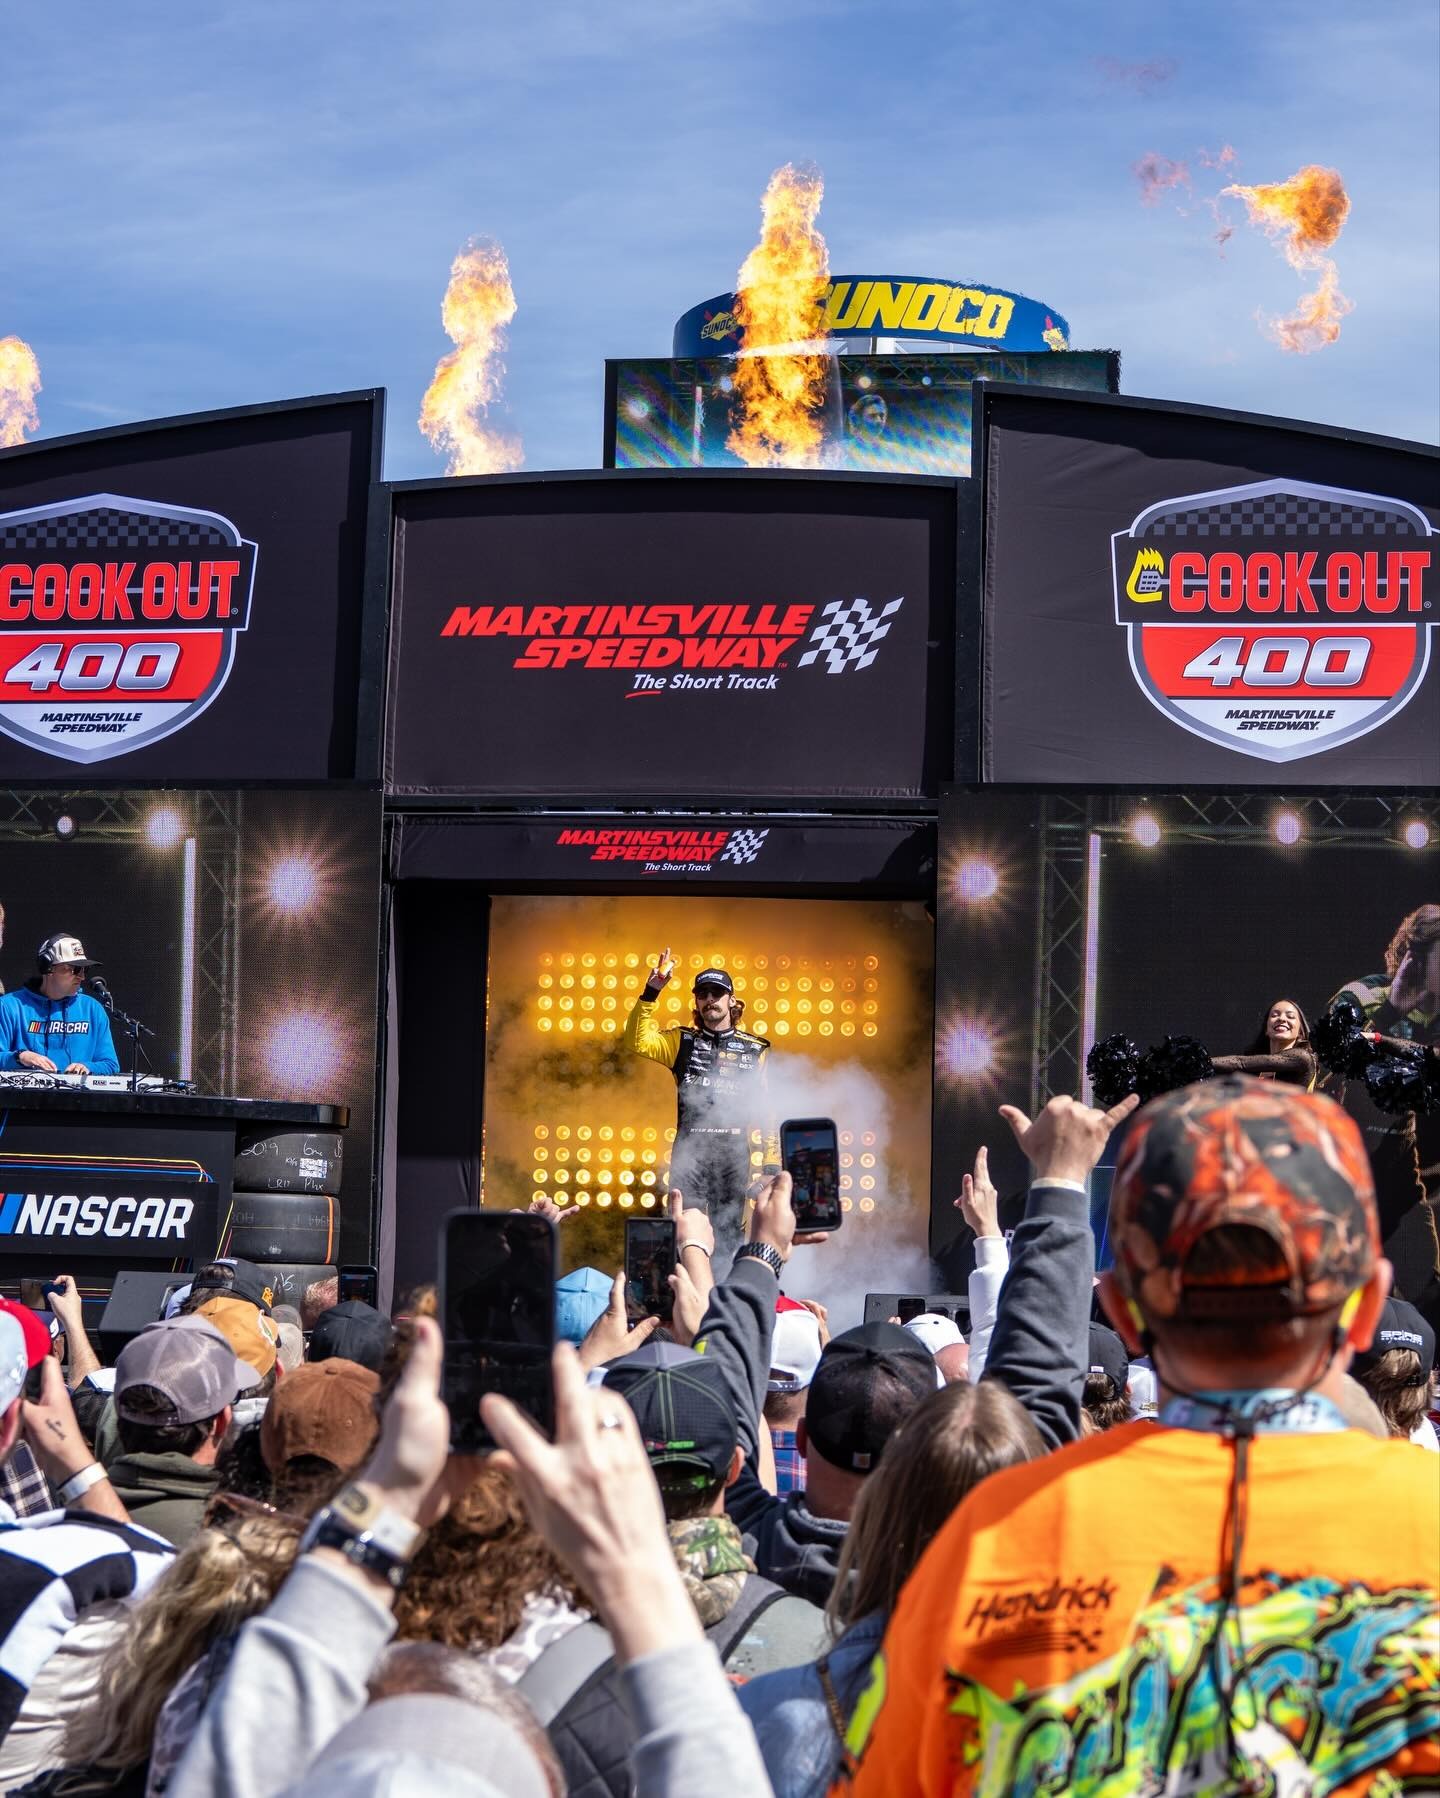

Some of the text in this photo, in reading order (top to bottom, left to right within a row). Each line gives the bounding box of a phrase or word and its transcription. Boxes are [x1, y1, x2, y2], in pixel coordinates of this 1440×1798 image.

[824, 282, 1015, 338] UNOCO
[0, 560, 240, 621] COOK OUT
[1168, 551, 1431, 613] COOK OUT
[440, 604, 816, 637] MARTINSVILLE
[513, 637, 799, 669] SPEEDWAY
[1182, 636, 1372, 686] 400
[4, 642, 181, 691] 400
[633, 673, 780, 690] The Short Track
[40, 712, 143, 723] MARTINSVILLE
[1225, 709, 1336, 720] MARTINSVILLE
[1236, 721, 1319, 731] SPEEDWAY
[50, 723, 127, 733] SPEEDWAY
[556, 829, 730, 846] MARTINSVILLE
[590, 845, 722, 861] SPEEDWAY
[644, 862, 712, 872] The Short Track
[14, 1194, 194, 1239] NASCAR
